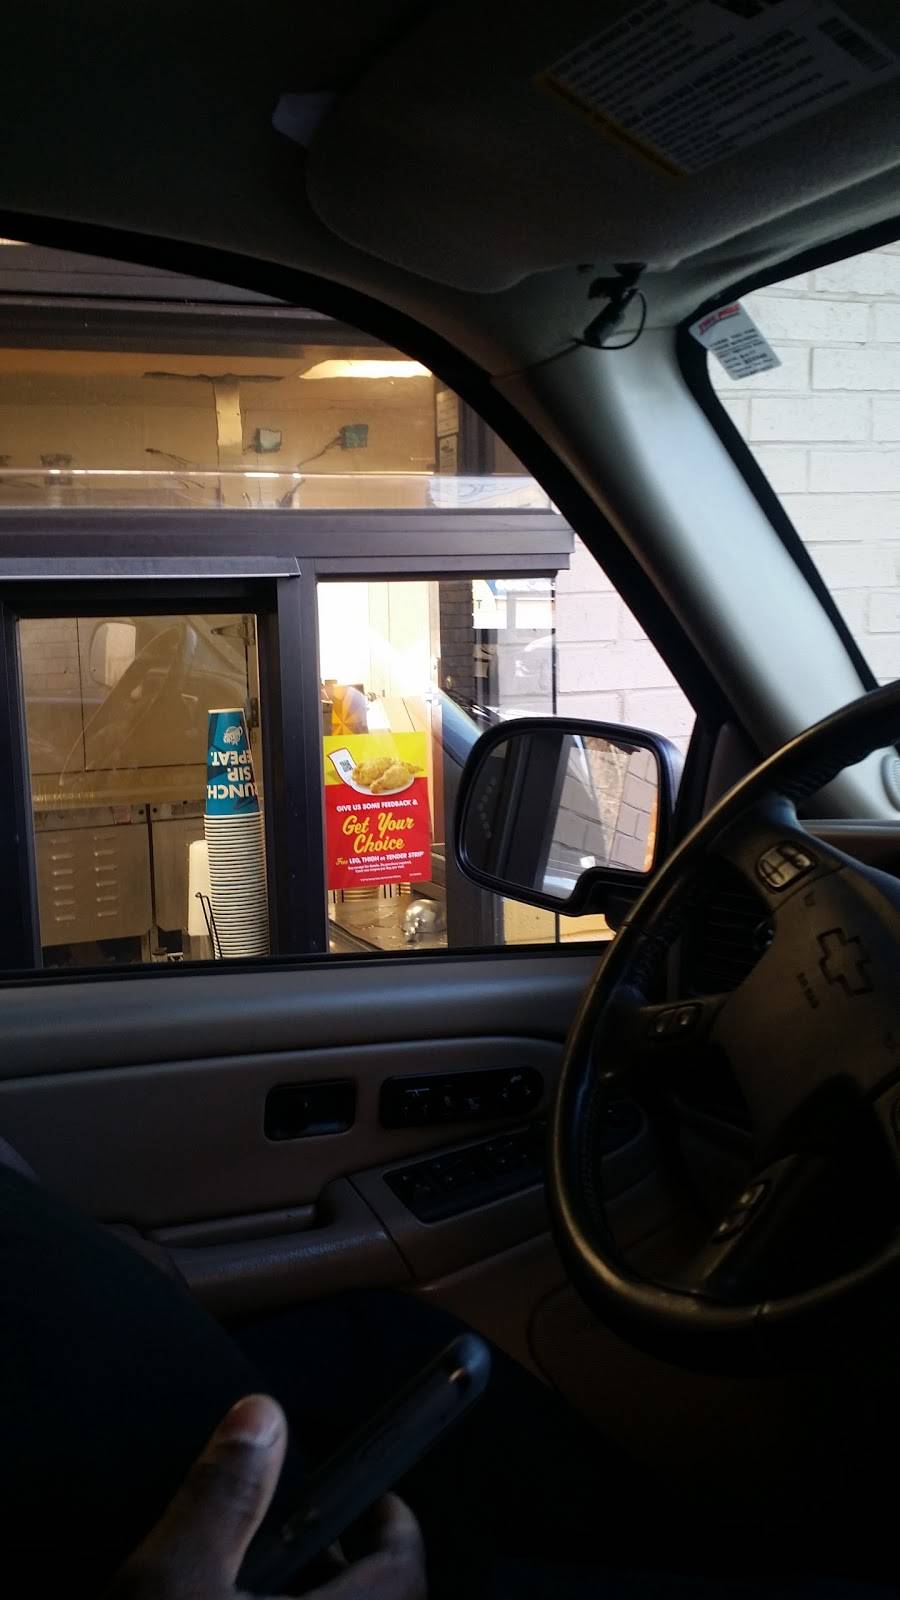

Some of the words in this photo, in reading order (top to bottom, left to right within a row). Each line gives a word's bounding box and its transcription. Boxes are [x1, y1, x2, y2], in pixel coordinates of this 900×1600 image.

[210, 749, 253, 766] EPEAT.
[227, 765, 252, 781] SIP.
[352, 803, 361, 811] US
[362, 802, 380, 810] SOME
[381, 799, 412, 808] FEEDBACK
[342, 814, 370, 835] Get
[377, 812, 415, 839] Your
[353, 833, 405, 854] Choice
[386, 852, 407, 861] TENDER
